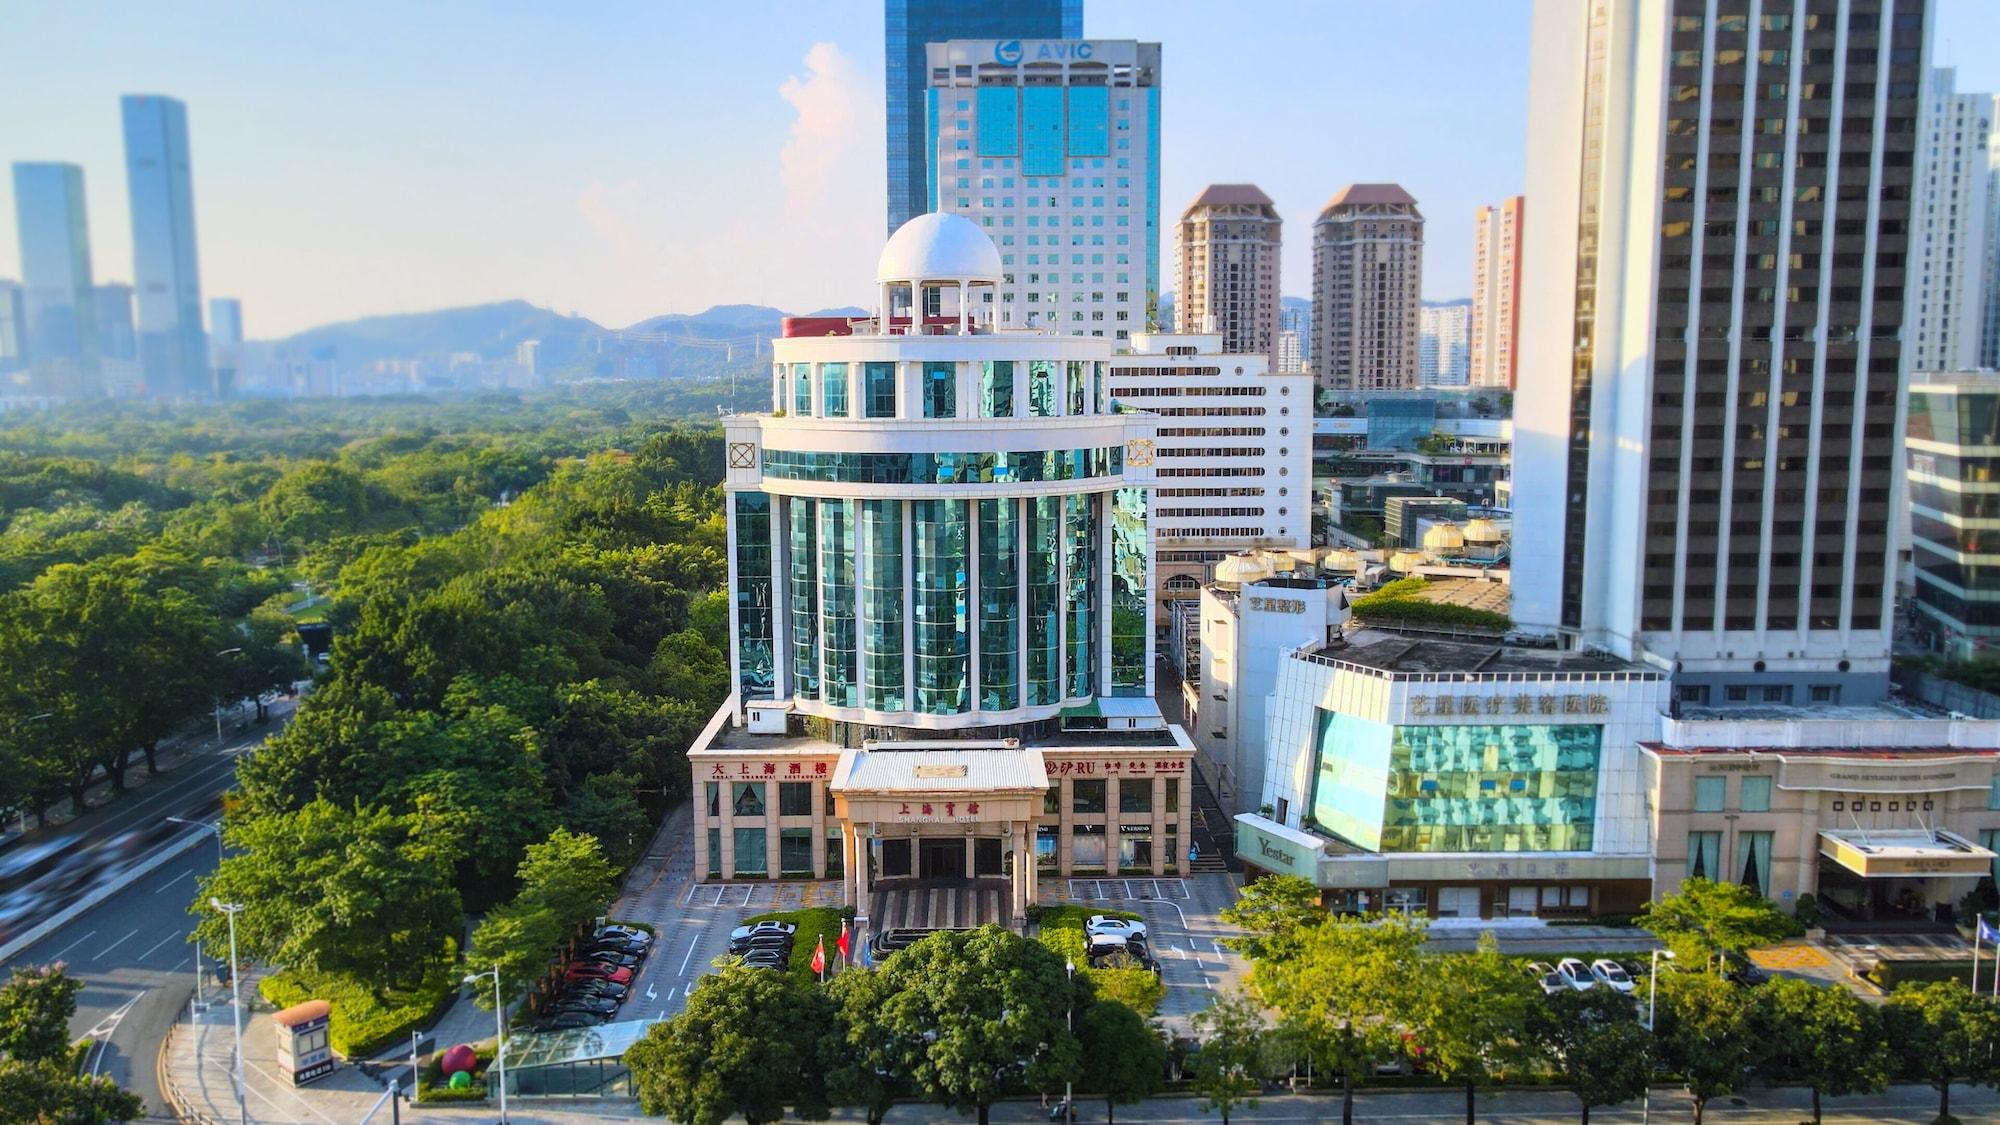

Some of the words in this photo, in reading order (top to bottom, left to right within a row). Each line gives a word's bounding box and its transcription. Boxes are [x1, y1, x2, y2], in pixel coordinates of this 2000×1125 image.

[1039, 43, 1093, 59] AVIC
[1410, 693, 1609, 715] 艺星医疗美容医院
[898, 815, 944, 823] SHANGHAI
[953, 815, 978, 823] HOTEL
[1257, 836, 1296, 866] Yestar
